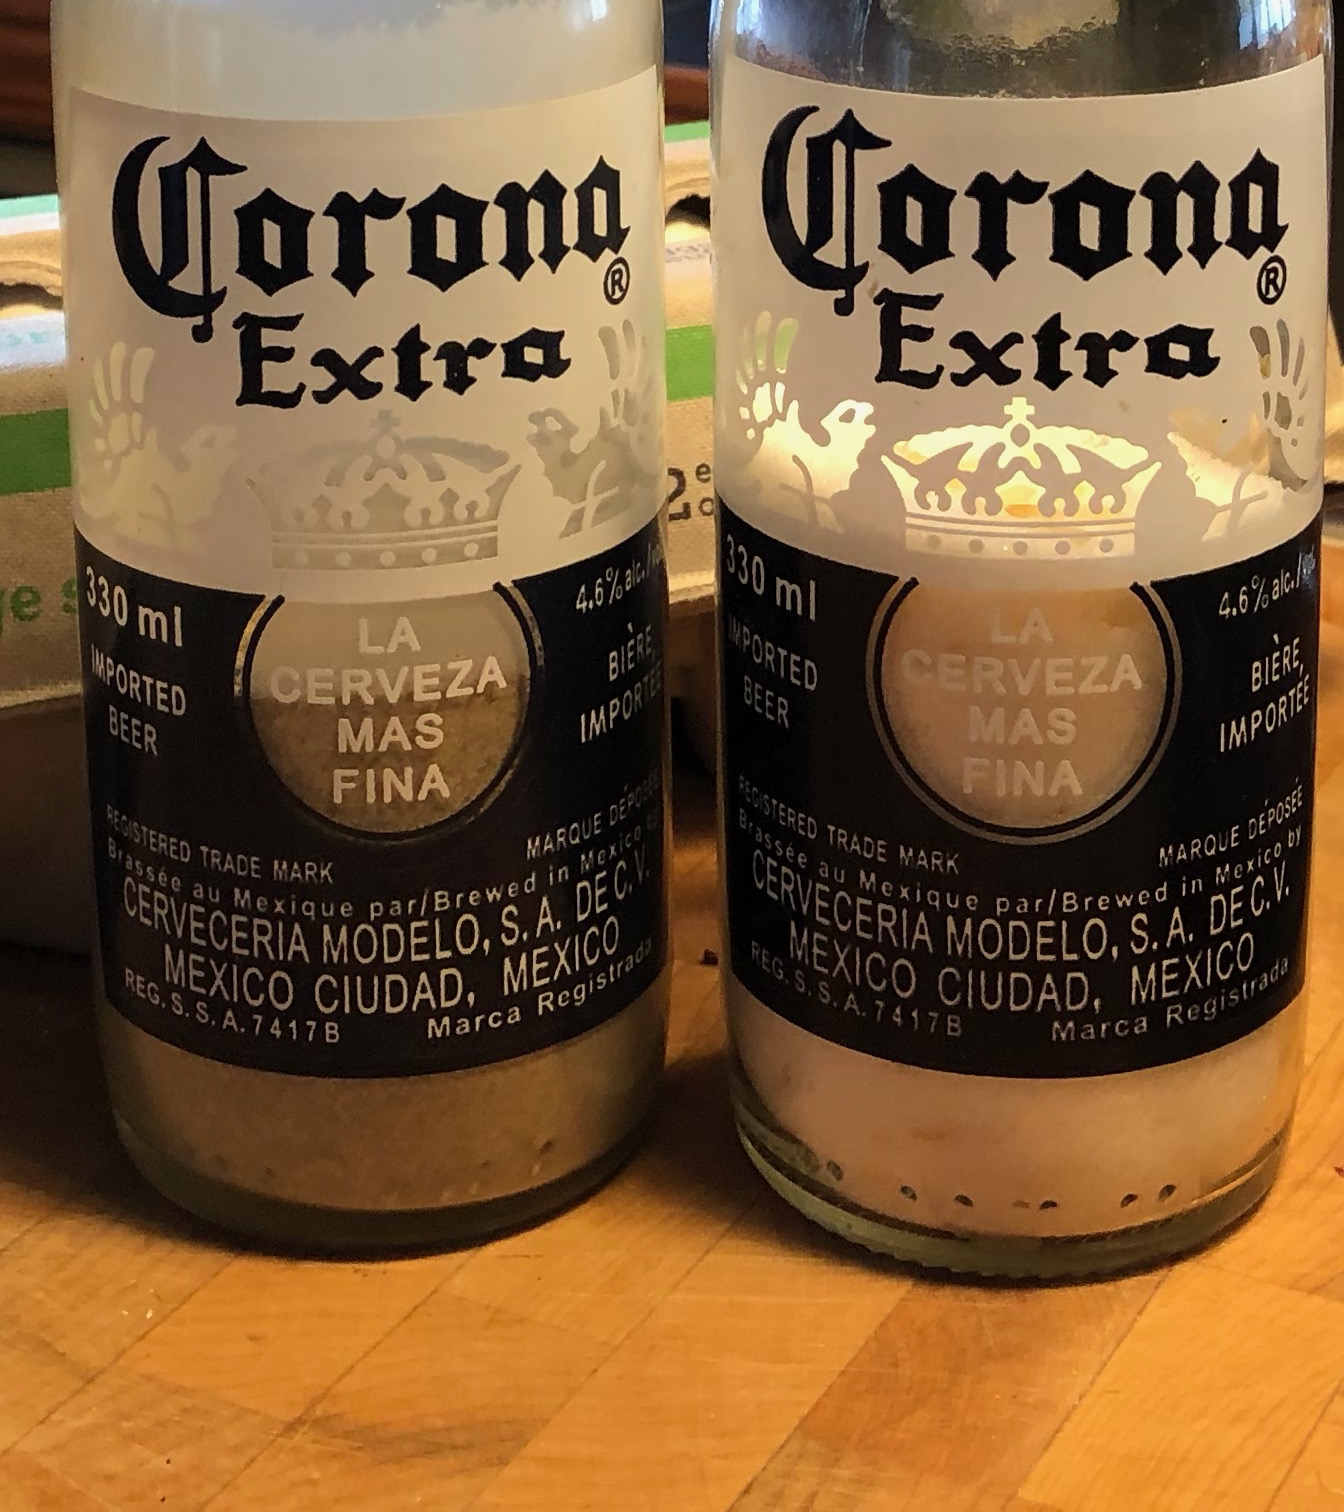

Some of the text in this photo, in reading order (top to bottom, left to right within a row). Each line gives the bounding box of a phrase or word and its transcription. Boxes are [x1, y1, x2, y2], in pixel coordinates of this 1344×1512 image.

[112, 136, 630, 343] Corona
[761, 105, 1288, 316] Corona
[233, 312, 572, 409] Extra
[873, 288, 1221, 392] Extra
[86, 565, 128, 626] 330
[138, 604, 183, 647] ml
[726, 534, 816, 622] 330 ml
[358, 617, 421, 654] LA
[609, 622, 652, 681] BIÈRE
[729, 612, 817, 691] IMPORTED
[991, 607, 1053, 644] LA
[1251, 633, 1301, 693] BIÈRE
[91, 644, 186, 716] IMPORTED
[270, 656, 507, 706] CERVEZA
[744, 675, 789, 730] BEER
[902, 649, 1142, 696] CERVEZA
[1219, 663, 1310, 753] IMPORTÉE
[109, 705, 158, 756] BEER
[338, 713, 444, 753] MAS
[969, 705, 1077, 745] MAS
[333, 763, 450, 804] FINA
[962, 757, 1083, 796] FINA
[106, 805, 334, 884] REGISTERED TRADE MARK
[527, 813, 602, 860] MARQUE
[739, 775, 959, 875] REGISTERED TRADE MARK
[739, 808, 807, 869] Brassée
[819, 861, 845, 884] au
[859, 869, 978, 912] Mexique
[1182, 876, 1203, 897] in
[1215, 843, 1281, 885] Mexico
[1288, 823, 1302, 848] by
[1159, 776, 1303, 868] MARQUE DÉPOSÉE
[108, 837, 181, 892] Brassée
[193, 882, 220, 903] au
[234, 888, 353, 921] Mexique
[549, 865, 569, 886] in
[580, 828, 641, 874] Mexico
[752, 849, 933, 954] CERVECERIA
[946, 917, 1119, 963] MODELO,
[123, 877, 310, 964] CERVECERIA
[322, 913, 491, 965] MODELO,
[164, 915, 619, 1015] MEXICO CIUDAD, MEXICO
[428, 939, 652, 1039] Marca Registrada
[789, 920, 1254, 1014] MEXICO CIUDAD, MEXICO
[1051, 956, 1289, 1041] Marca Registrada
